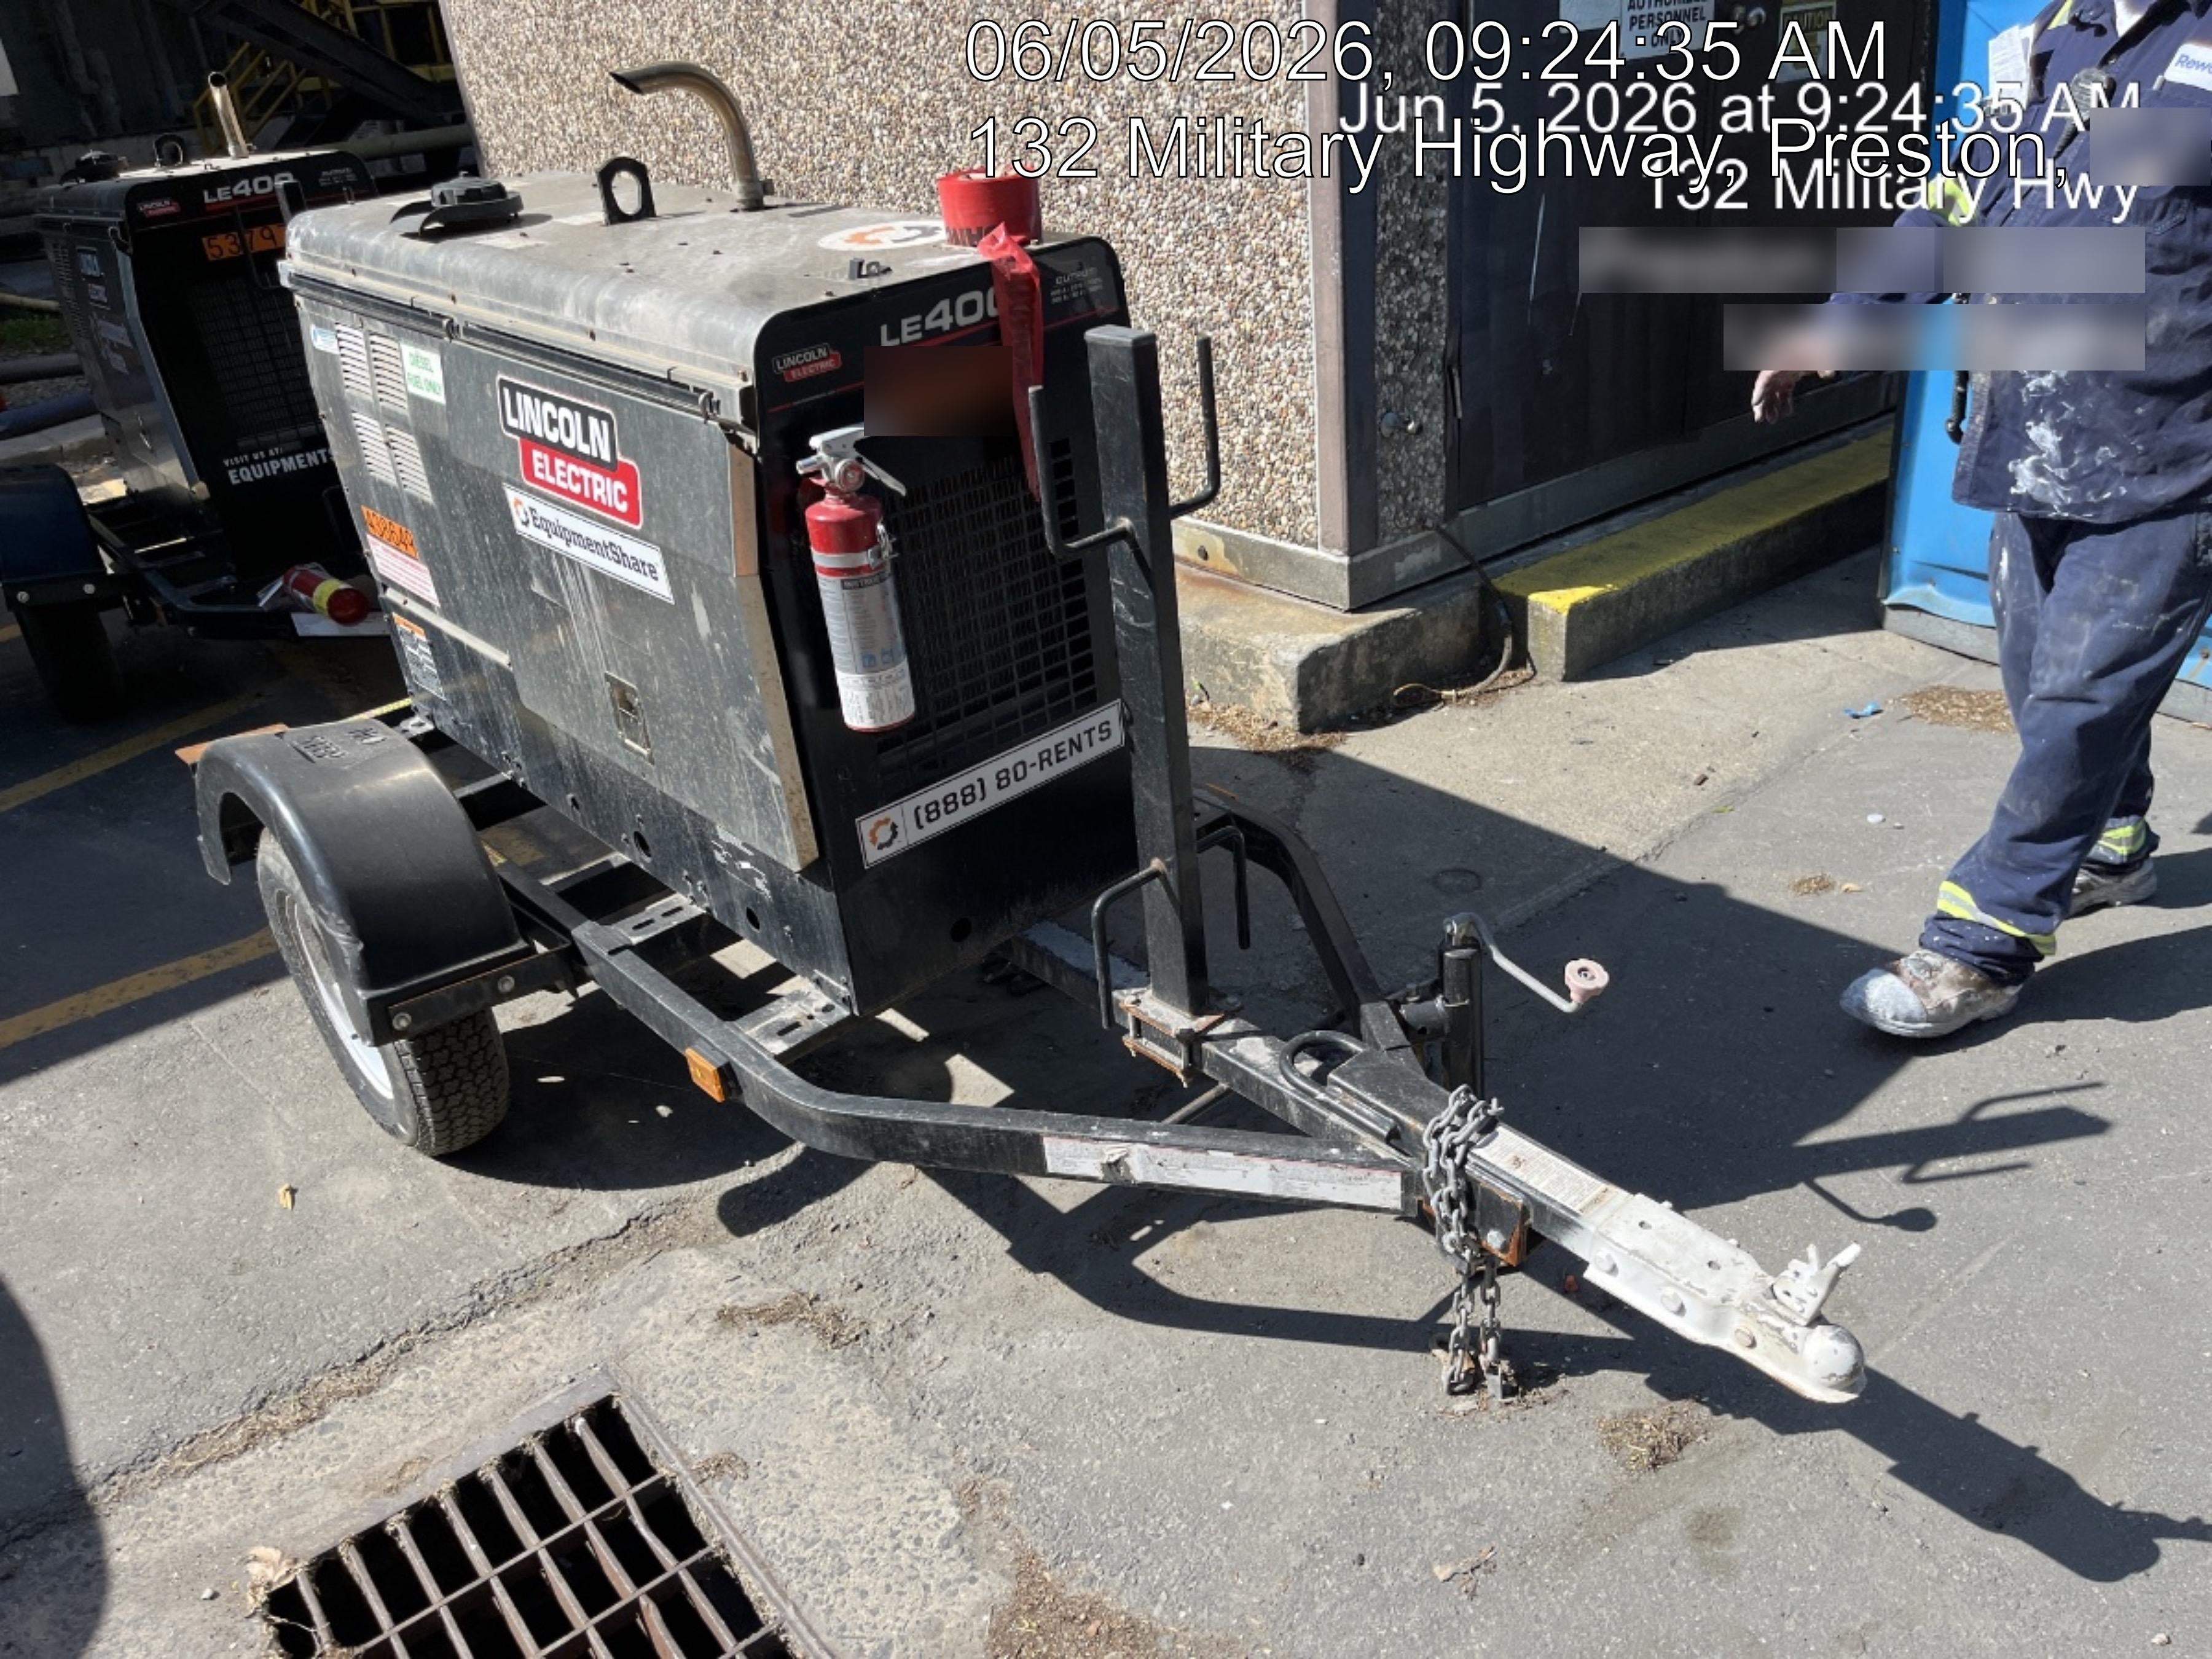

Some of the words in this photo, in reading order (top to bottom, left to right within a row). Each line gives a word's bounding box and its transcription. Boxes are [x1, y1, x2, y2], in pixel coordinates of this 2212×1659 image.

[1629, 5, 1706, 31] PERSONNEL
[776, 347, 828, 371] LINCOLN
[790, 359, 836, 378] ELECTRIC
[503, 386, 612, 463] LINCOLN
[531, 450, 628, 514] ELECTRIC
[530, 506, 659, 581] EquipmentShare
[914, 777, 987, 830] (888)
[995, 720, 1113, 791] 80-RENTS
